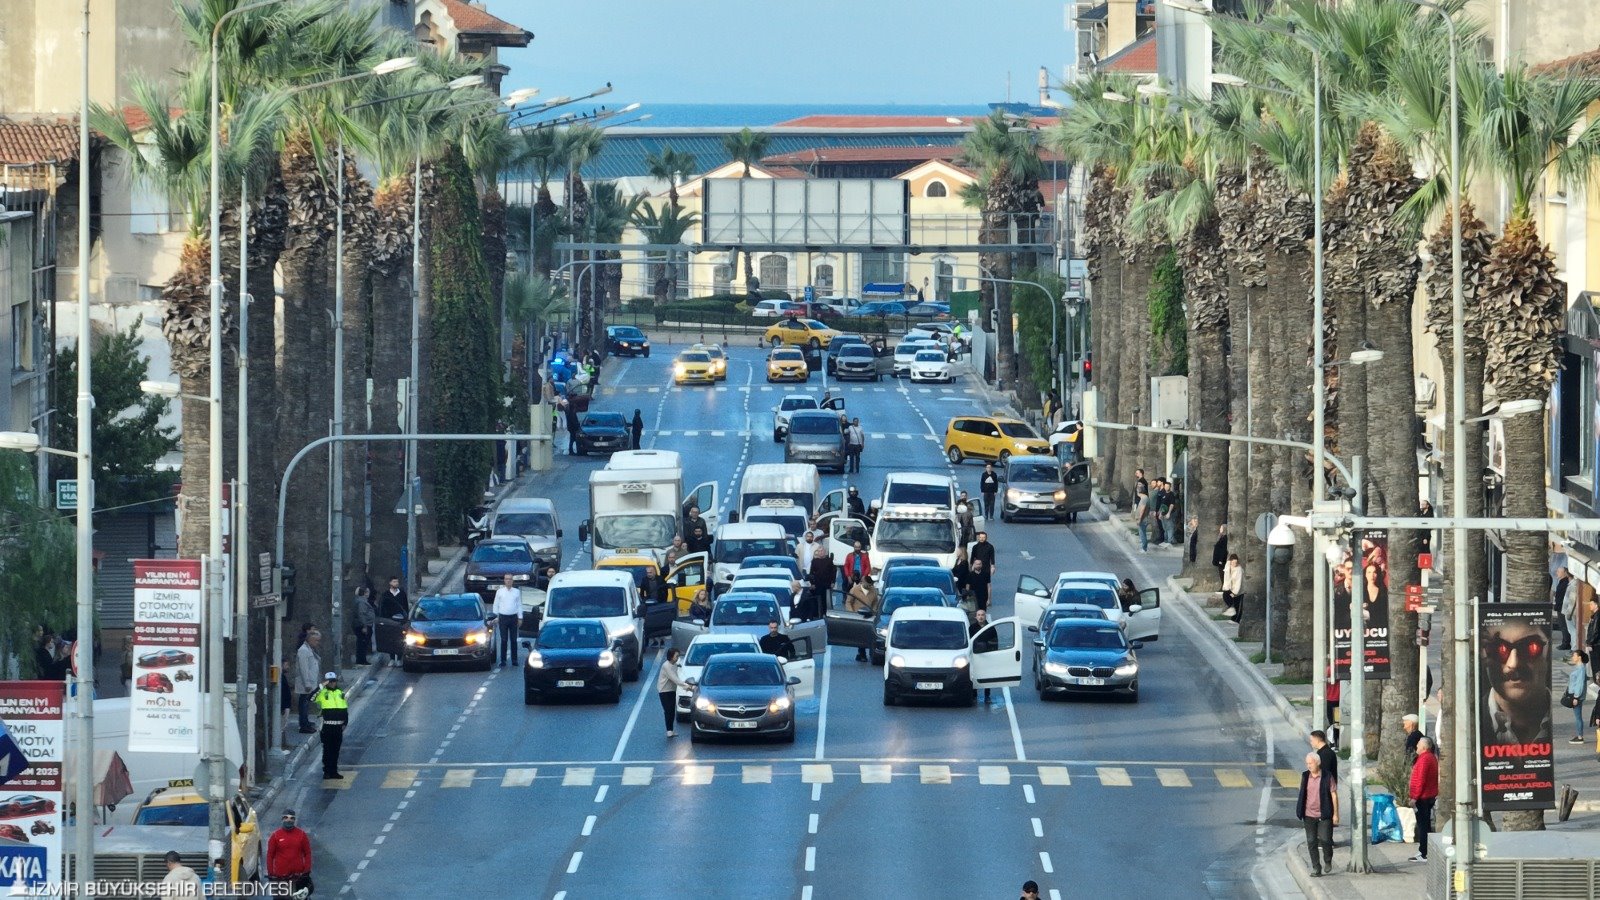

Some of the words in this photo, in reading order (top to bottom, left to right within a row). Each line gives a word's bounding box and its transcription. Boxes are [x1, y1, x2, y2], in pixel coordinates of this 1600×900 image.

[180, 571, 190, 579] İYİ
[153, 591, 180, 601] İZMİR
[139, 601, 194, 611] OTOMOTİV
[139, 611, 194, 620] FUARINDA!
[1335, 627, 1387, 639] UYUCU
[19, 698, 33, 706] EN
[35, 697, 48, 706] İYİ
[1484, 743, 1551, 758] UYKUCU
[36, 768, 59, 776] 2025
[1499, 773, 1537, 781] SADECE
[170, 779, 193, 787] TAK
[1484, 782, 1553, 791] SİNEMALARDA
